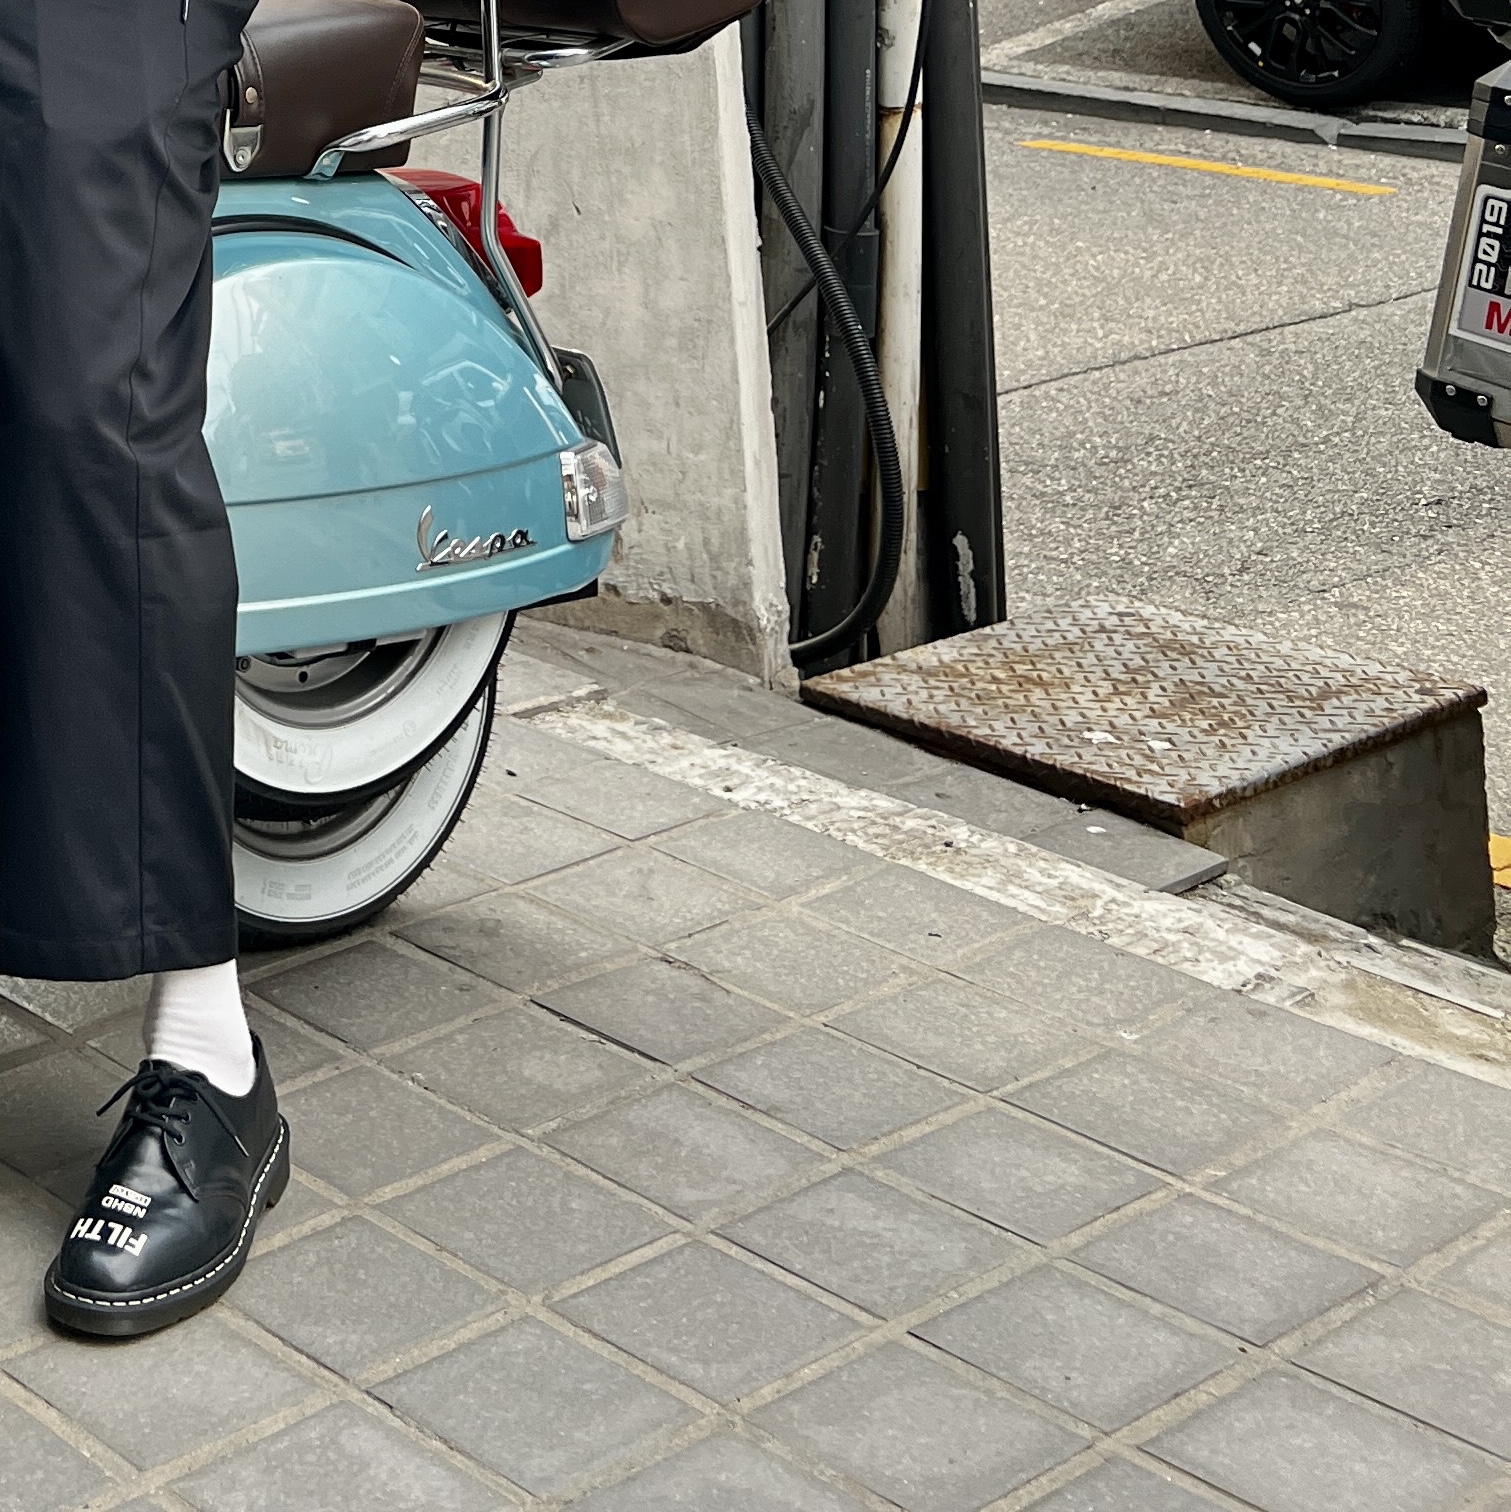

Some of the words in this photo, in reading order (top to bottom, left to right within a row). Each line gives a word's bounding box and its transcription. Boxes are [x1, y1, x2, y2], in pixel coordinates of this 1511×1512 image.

[1472, 198, 1508, 290] 2019
[416, 504, 536, 572] Vespa
[101, 1195, 147, 1218] NBHD
[69, 1217, 148, 1257] FILTH
